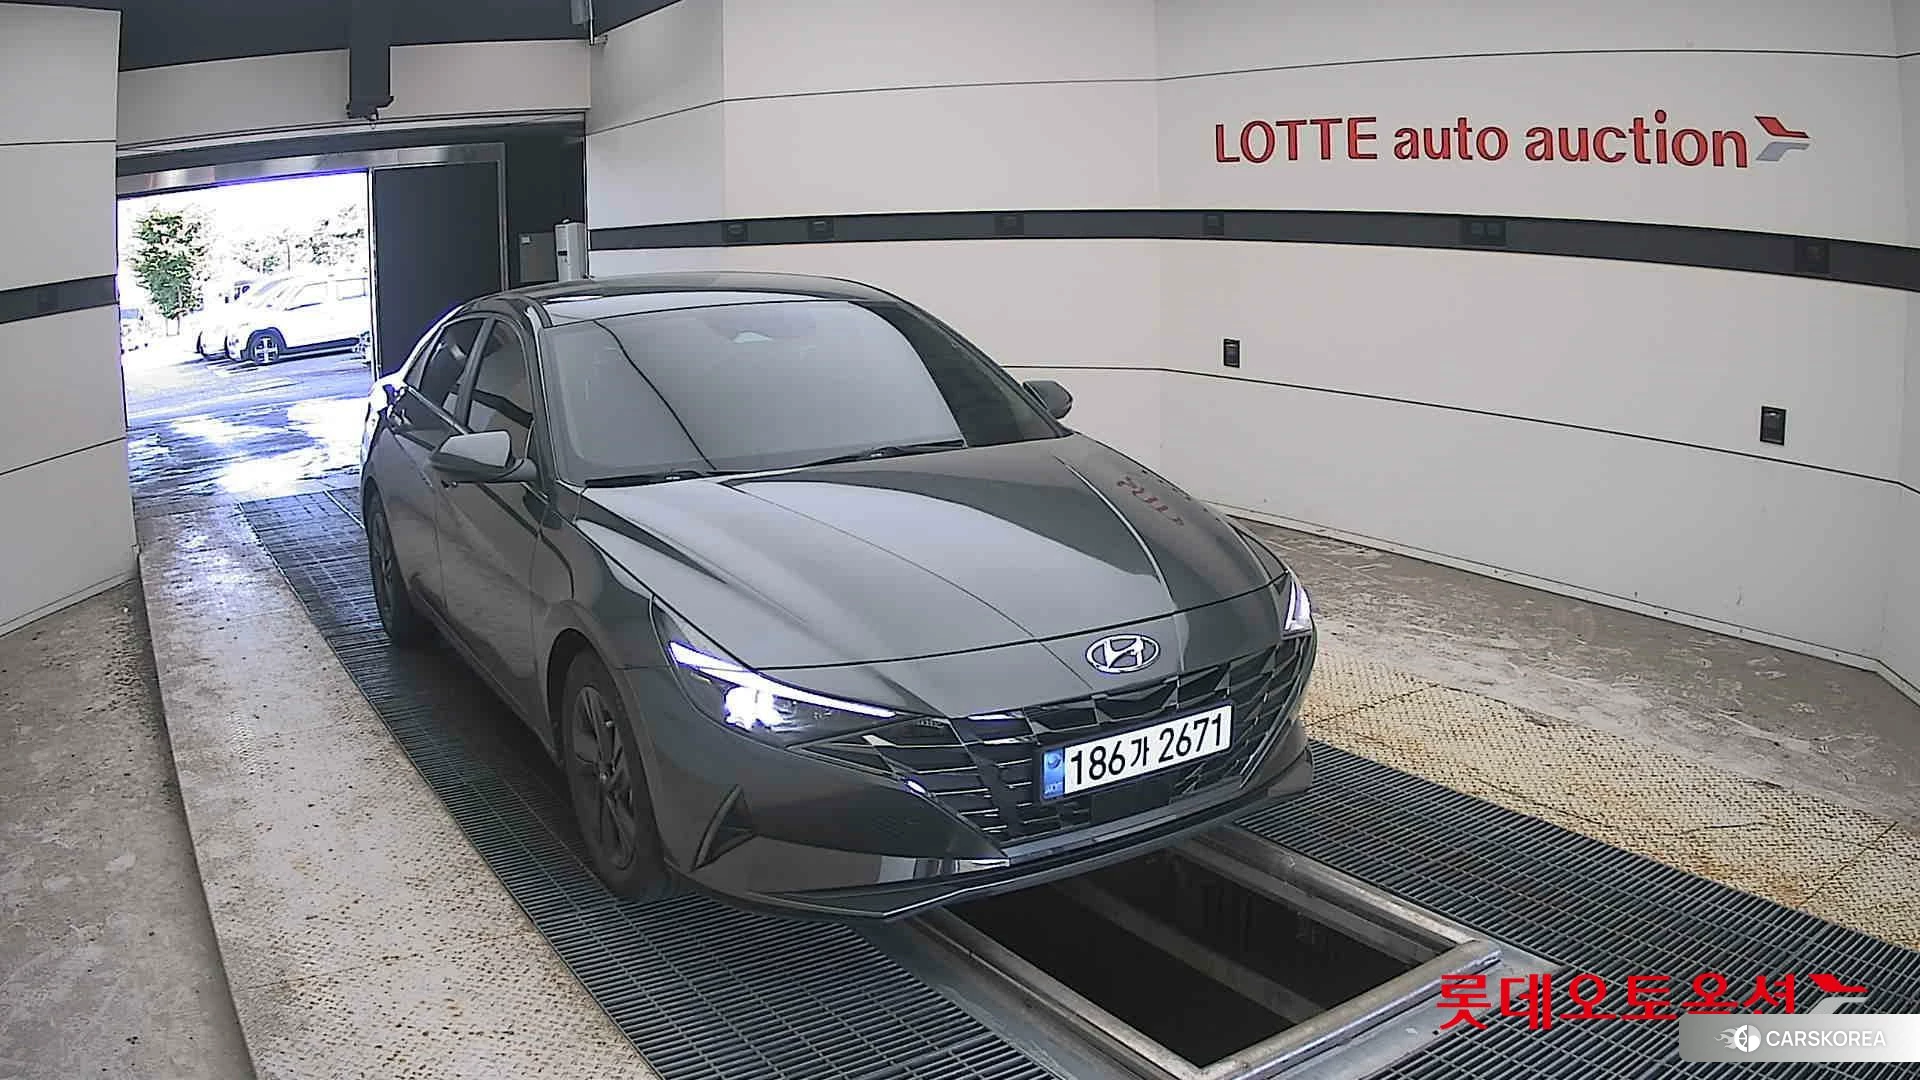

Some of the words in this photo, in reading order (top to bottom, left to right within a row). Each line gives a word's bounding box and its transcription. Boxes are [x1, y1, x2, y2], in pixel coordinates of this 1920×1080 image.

[1215, 117, 1377, 163] LOTTE
[1393, 117, 1509, 161] auto
[1524, 110, 1749, 168] auction
[1070, 735, 1150, 785] 186가
[1158, 712, 1222, 764] 2671
